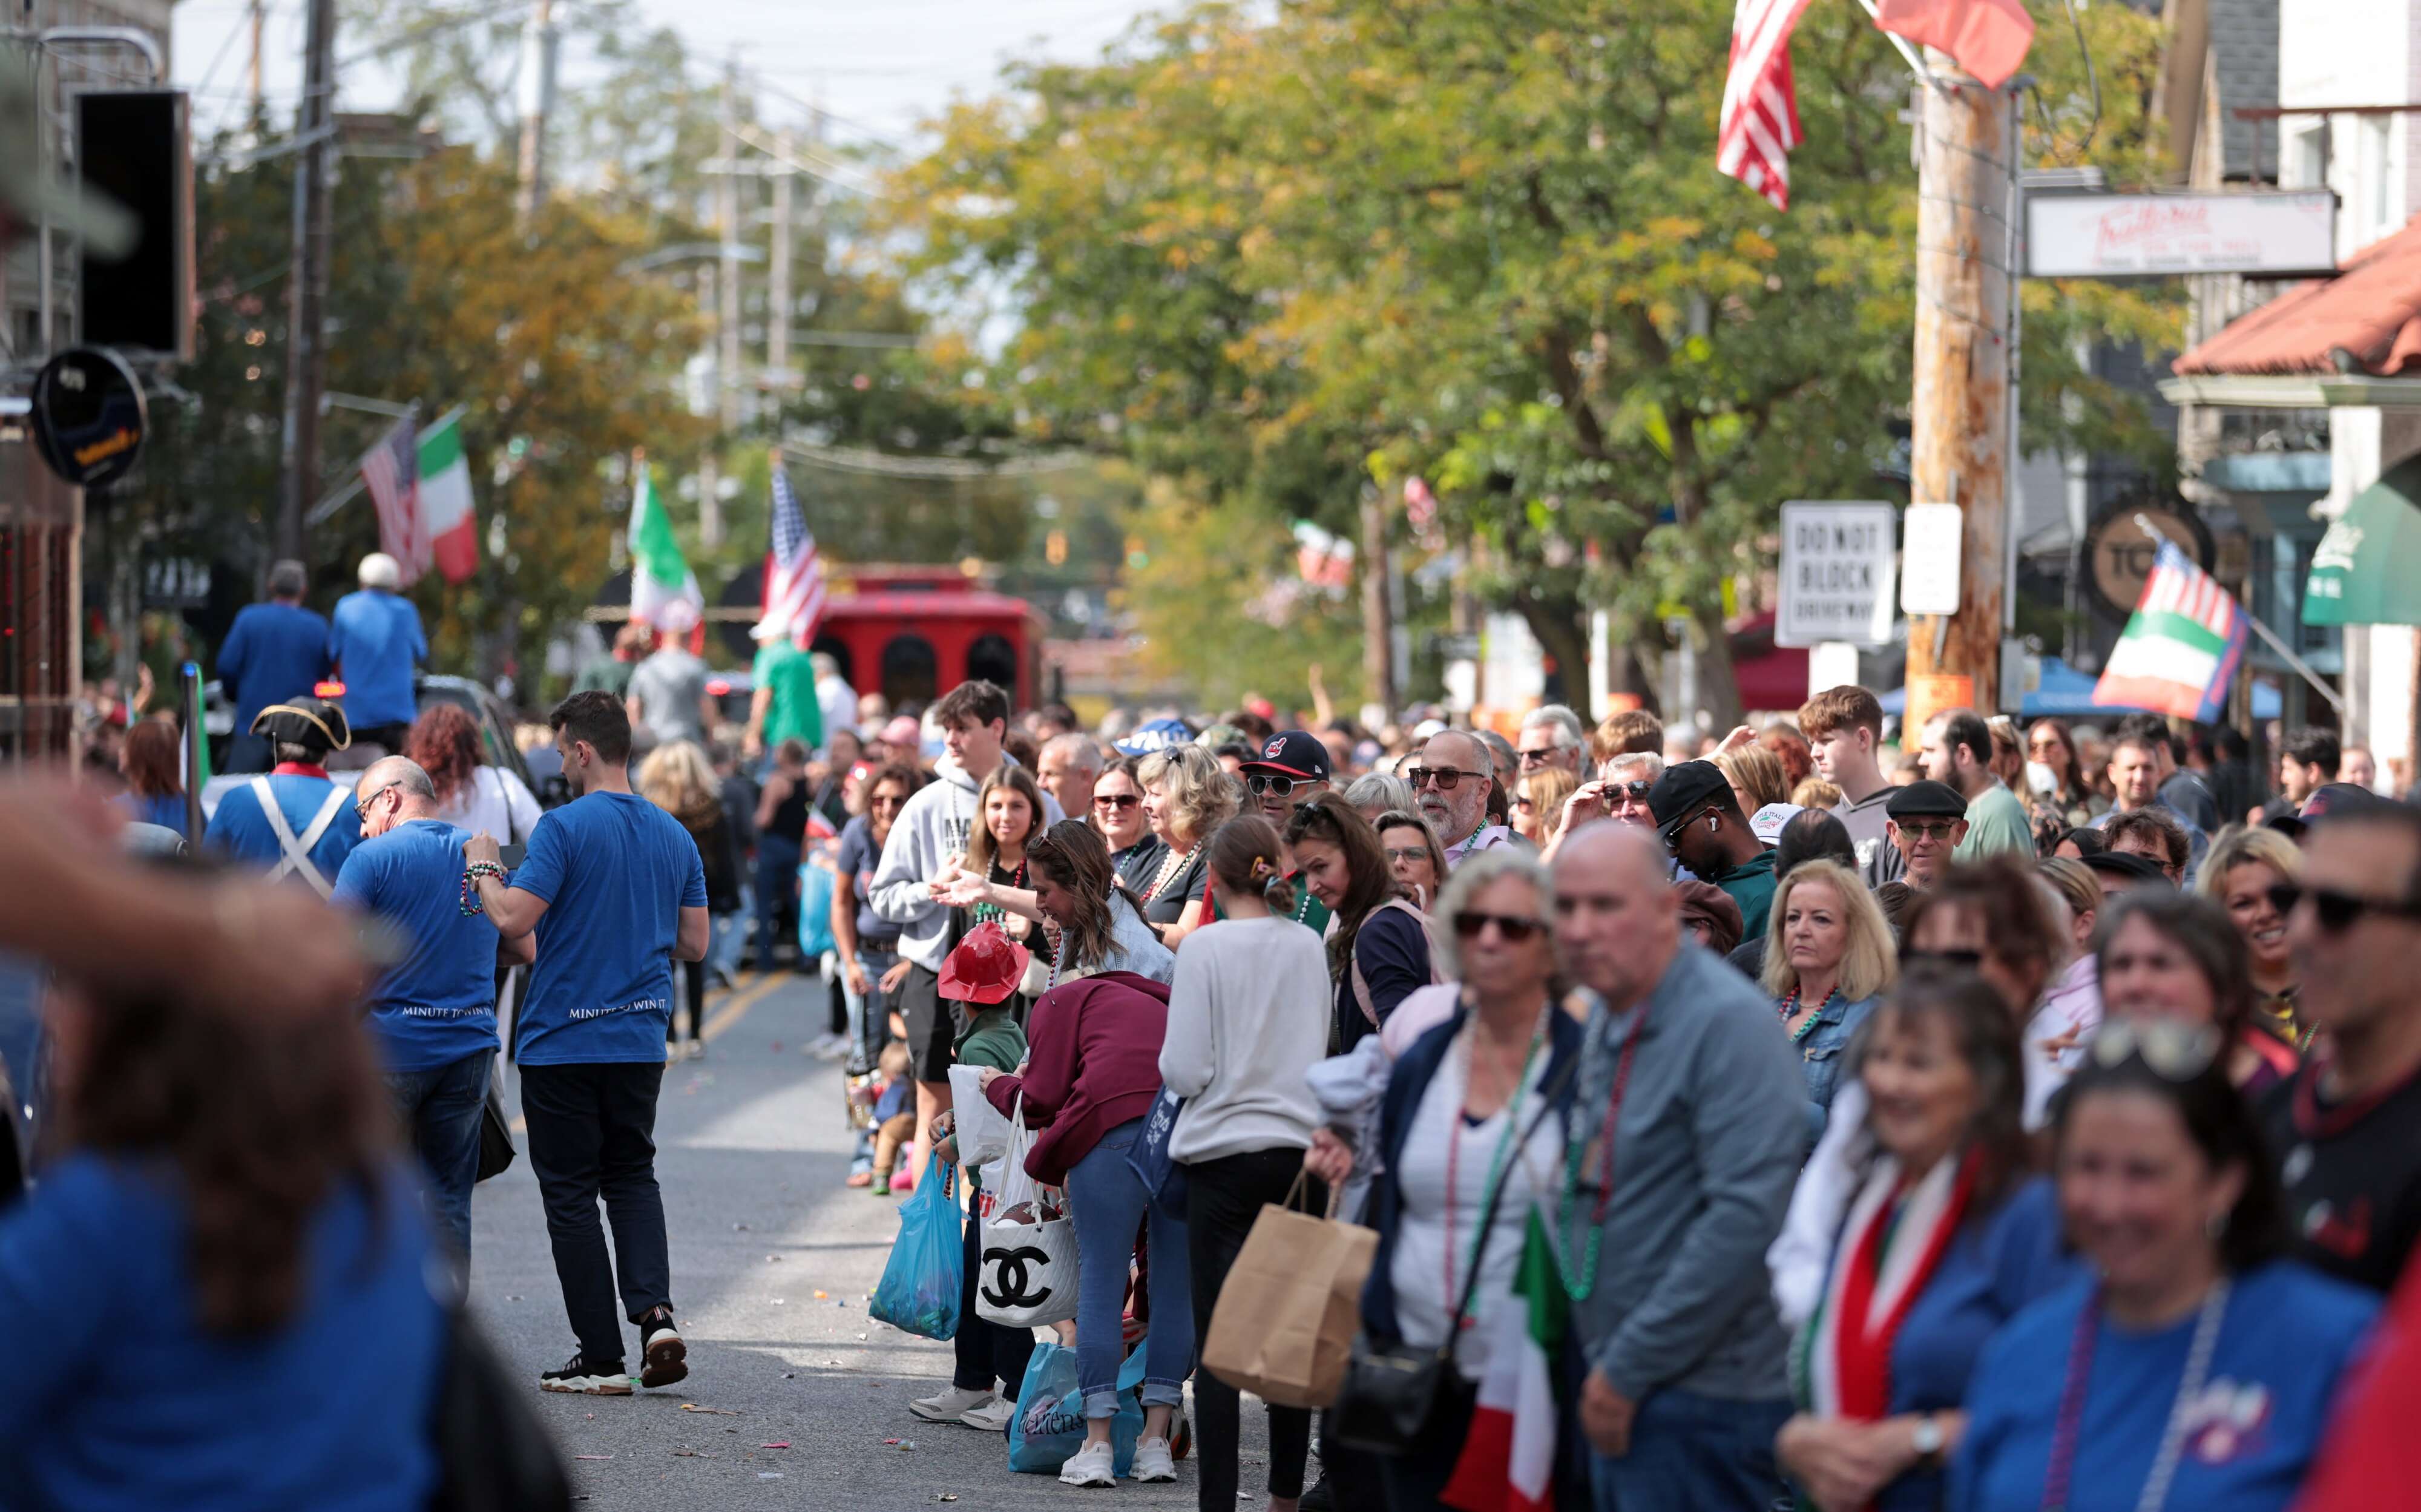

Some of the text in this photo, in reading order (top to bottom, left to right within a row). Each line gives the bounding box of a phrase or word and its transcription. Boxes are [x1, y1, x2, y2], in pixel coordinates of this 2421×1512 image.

[1796, 522, 1877, 553] DO NOT
[1798, 560, 1873, 593] BLOCK
[1796, 597, 1874, 622] DRIVEWAY
[1769, 811, 1785, 821] ITALY
[402, 1007, 448, 1017] MINUTE
[634, 1000, 657, 1010] WIN
[658, 999, 666, 1008] IT
